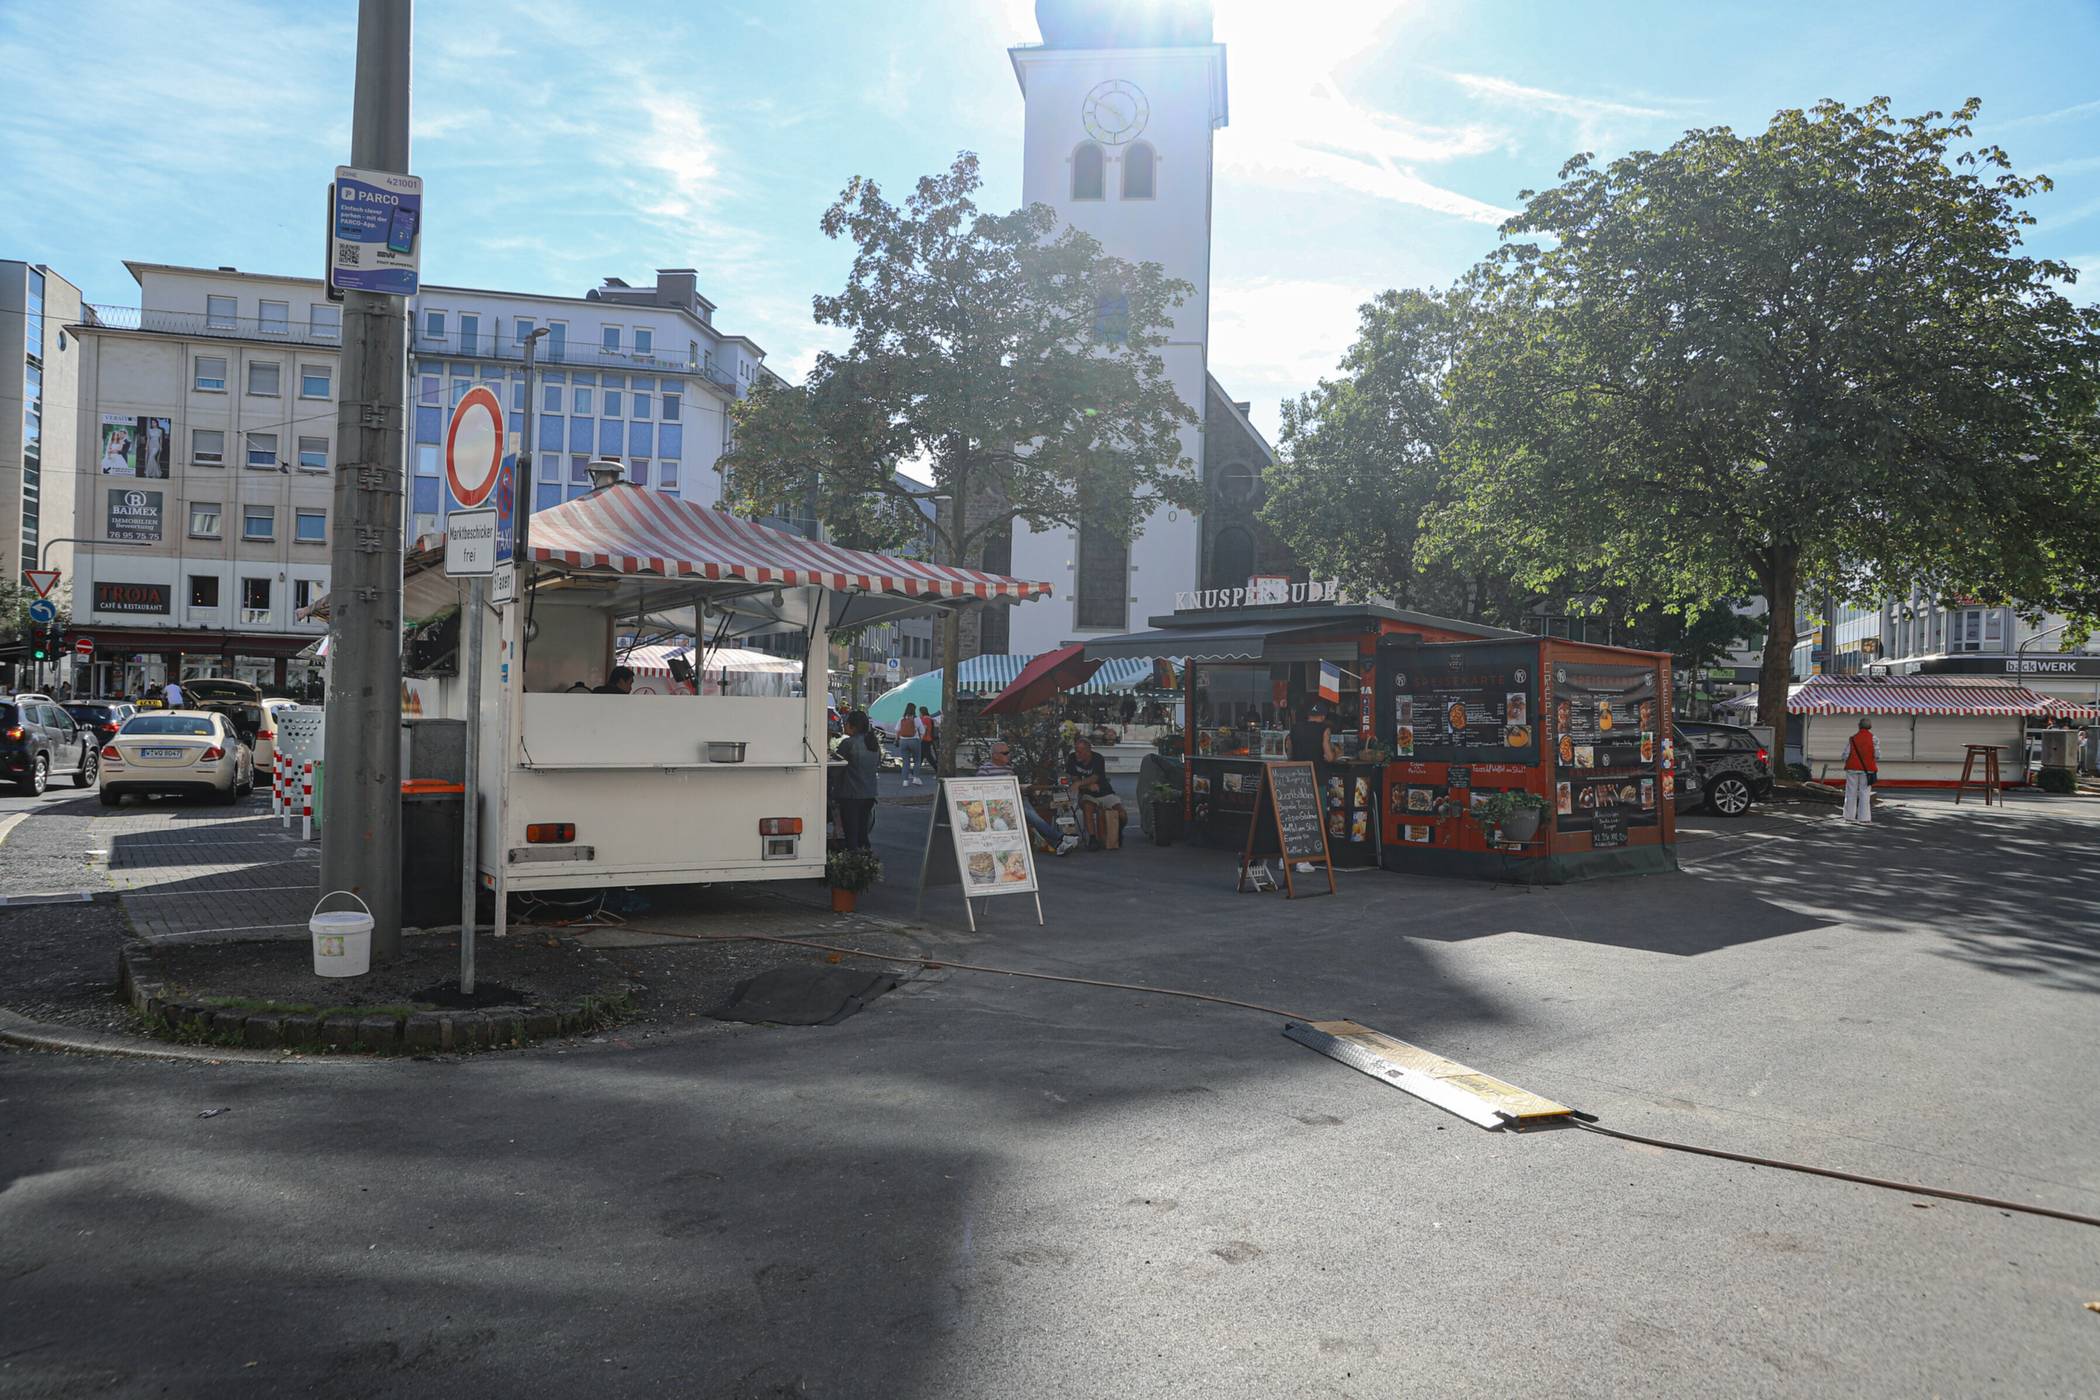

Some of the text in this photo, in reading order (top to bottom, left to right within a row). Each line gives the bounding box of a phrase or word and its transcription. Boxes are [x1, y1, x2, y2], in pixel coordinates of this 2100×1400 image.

[386, 177, 417, 189] 421001
[358, 191, 399, 206] PARCO
[113, 506, 158, 516] BAIMEX
[112, 517, 159, 525] IMMOBILIEN
[449, 524, 493, 541] Marktbeschicker
[463, 547, 477, 562] frei
[99, 586, 161, 602] TROJA
